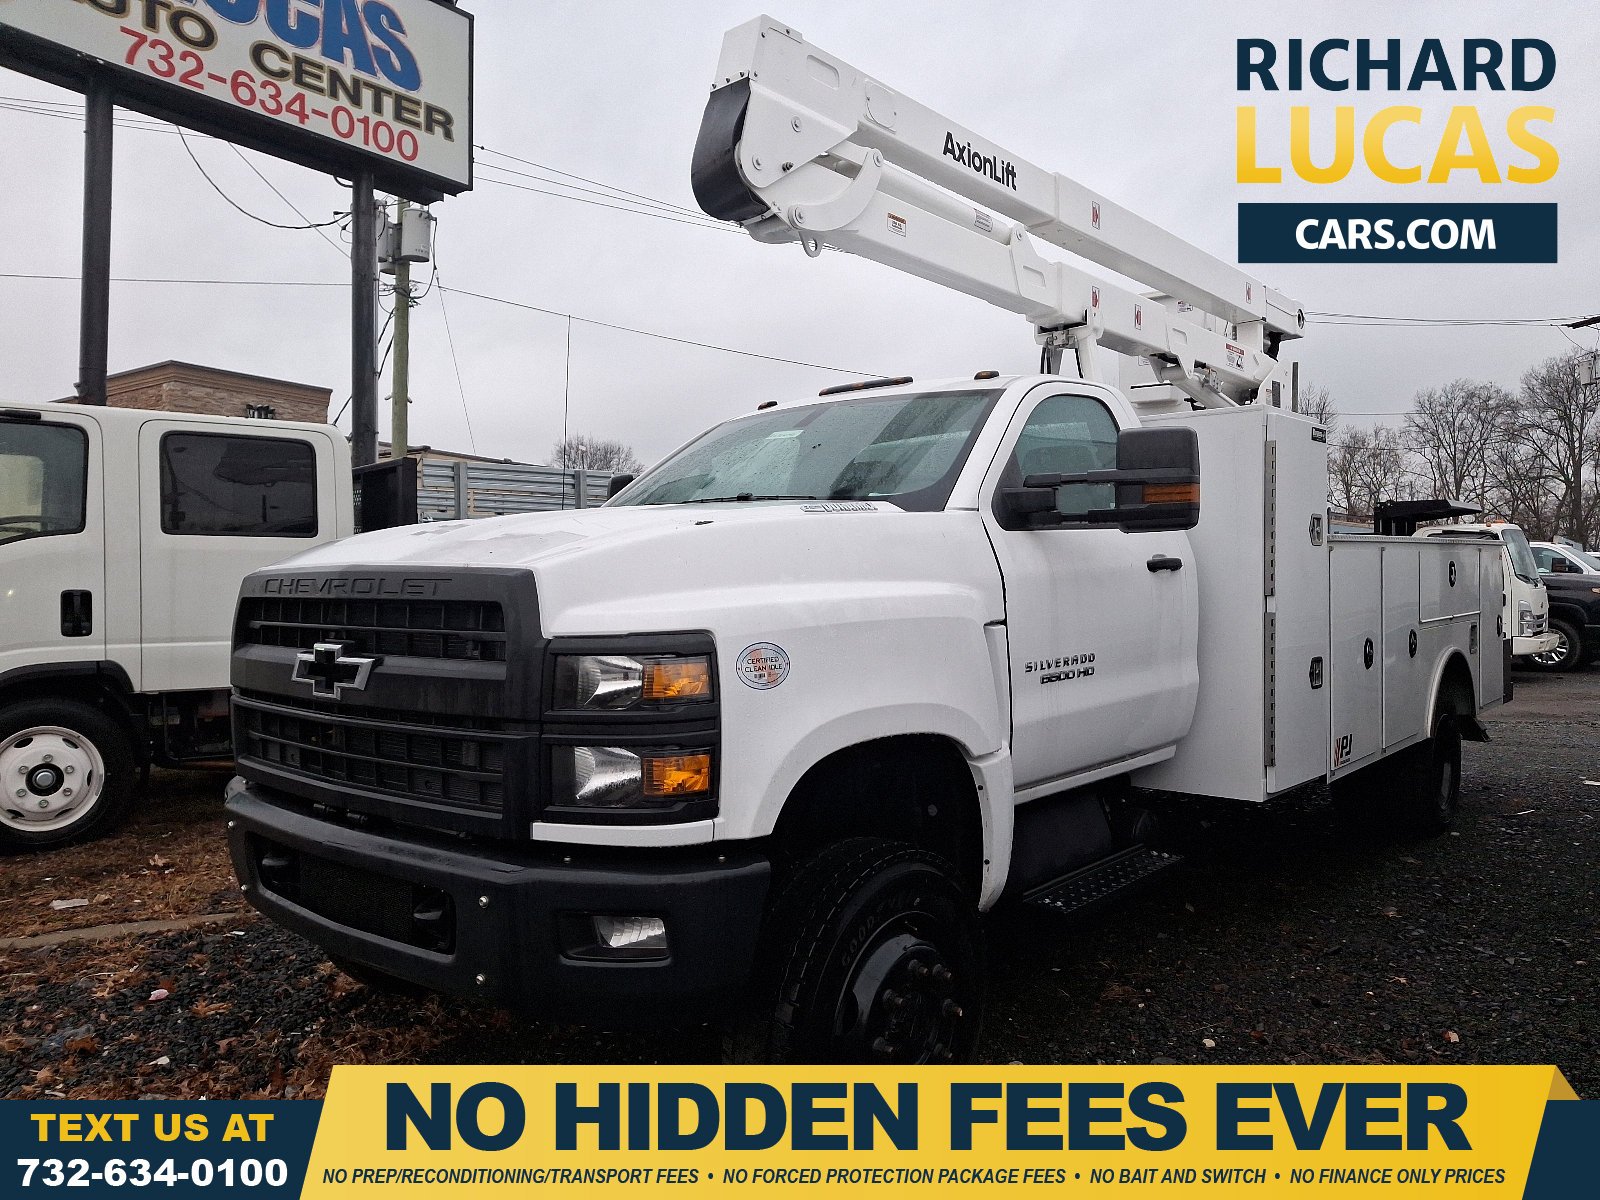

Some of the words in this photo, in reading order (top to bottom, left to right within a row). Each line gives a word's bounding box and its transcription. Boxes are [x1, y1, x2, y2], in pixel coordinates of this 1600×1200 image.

[119, 25, 419, 162] 732-634-0100
[249, 40, 455, 142] CENTER
[943, 131, 1017, 191] AxionLift
[265, 578, 452, 596] CHEVROLET
[744, 665, 767, 673] CLEAN
[747, 656, 780, 665] CERTIFIED
[1025, 653, 1096, 673] SILVERADO
